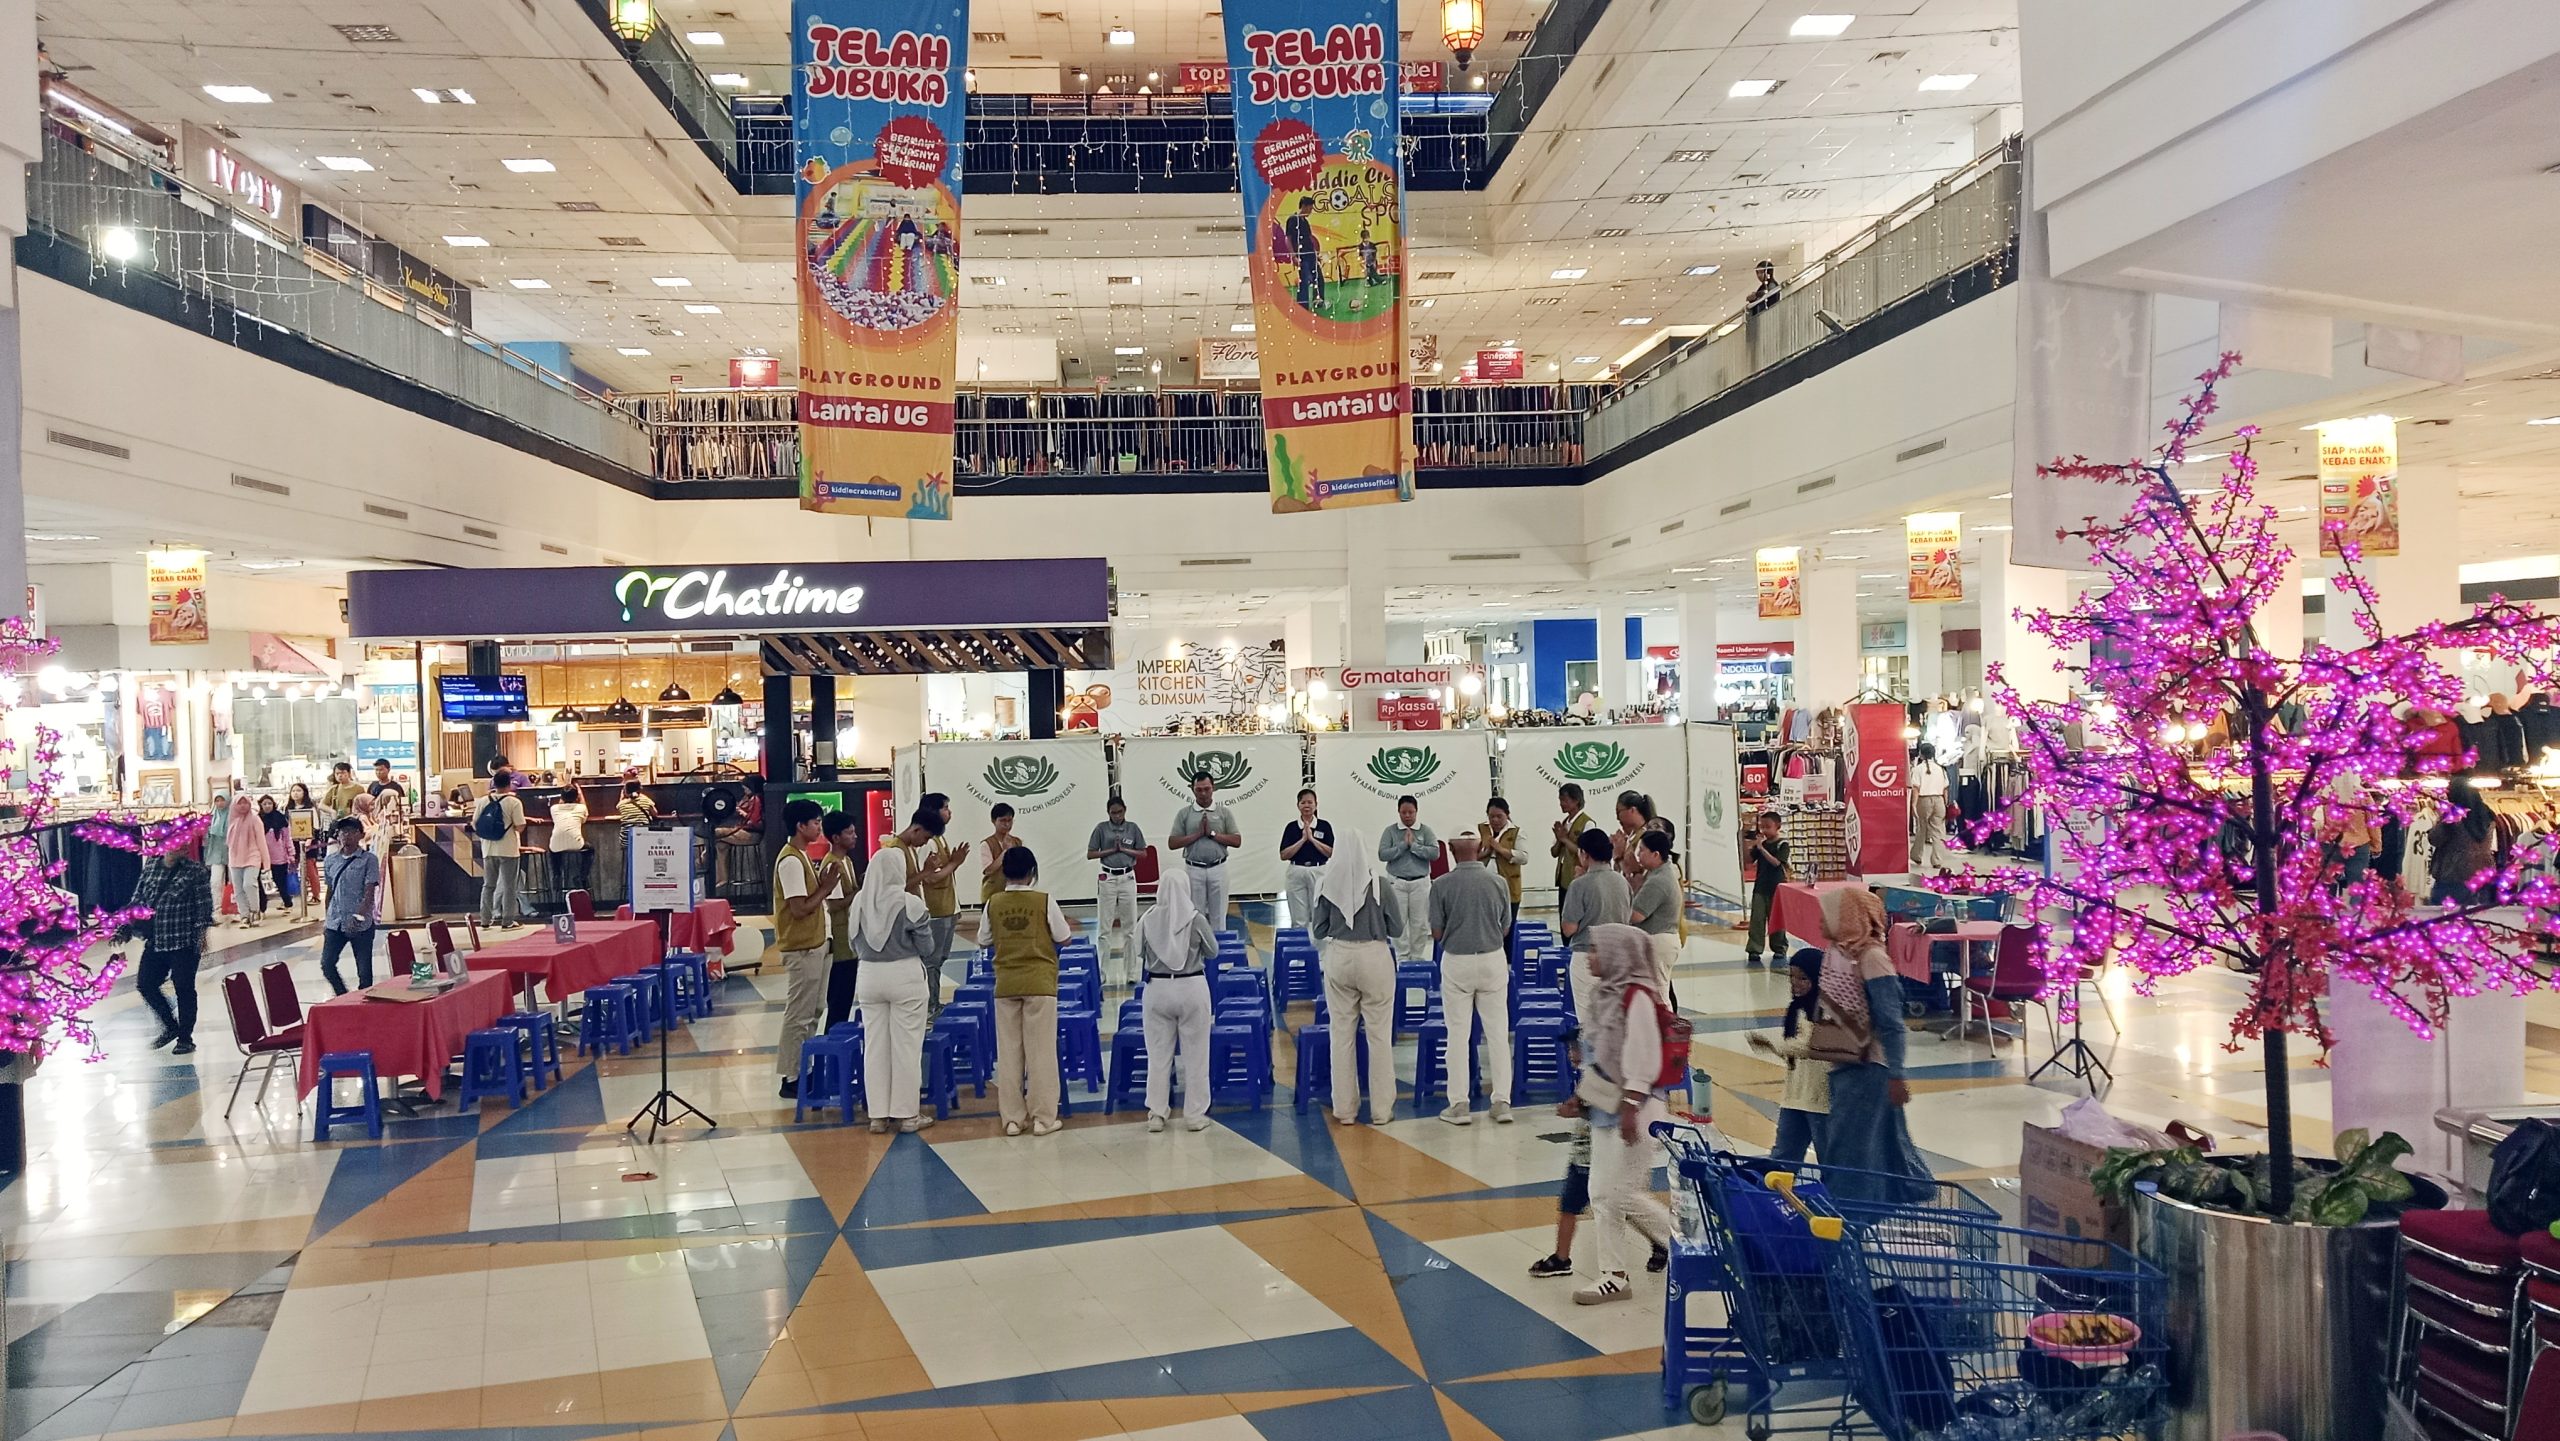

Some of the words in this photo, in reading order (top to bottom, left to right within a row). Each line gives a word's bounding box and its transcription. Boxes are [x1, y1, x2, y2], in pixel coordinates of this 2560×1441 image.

[809, 26, 949, 71] TELAH
[1247, 25, 1382, 68] TELAH
[1189, 64, 1226, 84] top
[1250, 64, 1384, 102] DIBUKA
[808, 65, 946, 105] DIBUKA
[890, 133, 935, 149] BERMAIN
[1263, 133, 1306, 155] BERMAIN
[882, 144, 940, 161] SEPUASNYA
[1261, 143, 1315, 168] SEPUASNYA
[883, 155, 936, 172] SEHARIAN!
[800, 366, 942, 391] PLAYGROUND
[809, 399, 890, 424] Lantai
[894, 405, 929, 427] UG
[1292, 393, 1374, 421] Lantai
[2322, 446, 2346, 455] SIAP
[2322, 457, 2356, 466] KEBAB
[2359, 456, 2391, 466] ENAK?
[1331, 478, 1396, 492] kiddiecrabsofficial
[663, 569, 864, 620] Chatime
[1137, 659, 1205, 674] IMPERIAL
[1365, 668, 1451, 685] matahari
[1721, 664, 1765, 673] INDONESIA
[1138, 676, 1206, 690] KITCHEN
[1139, 693, 1150, 706] &
[1152, 693, 1206, 705] DIMSUM
[1382, 704, 1395, 715] Rp
[1397, 700, 1435, 711] kassa
[1350, 771, 1377, 794] YAYASAN
[1377, 789, 1399, 801] BUDHA
[1414, 791, 1427, 799] CHI
[1427, 770, 1457, 795] INDONESIA
[1615, 762, 1646, 788] INDONESIA
[966, 782, 993, 806] YAYASAN
[1045, 782, 1077, 808] INDONESIA
[1159, 776, 1186, 800] YAYASAN
[1237, 778, 1269, 803] INDONESIA
[1863, 788, 1904, 797] matahari
